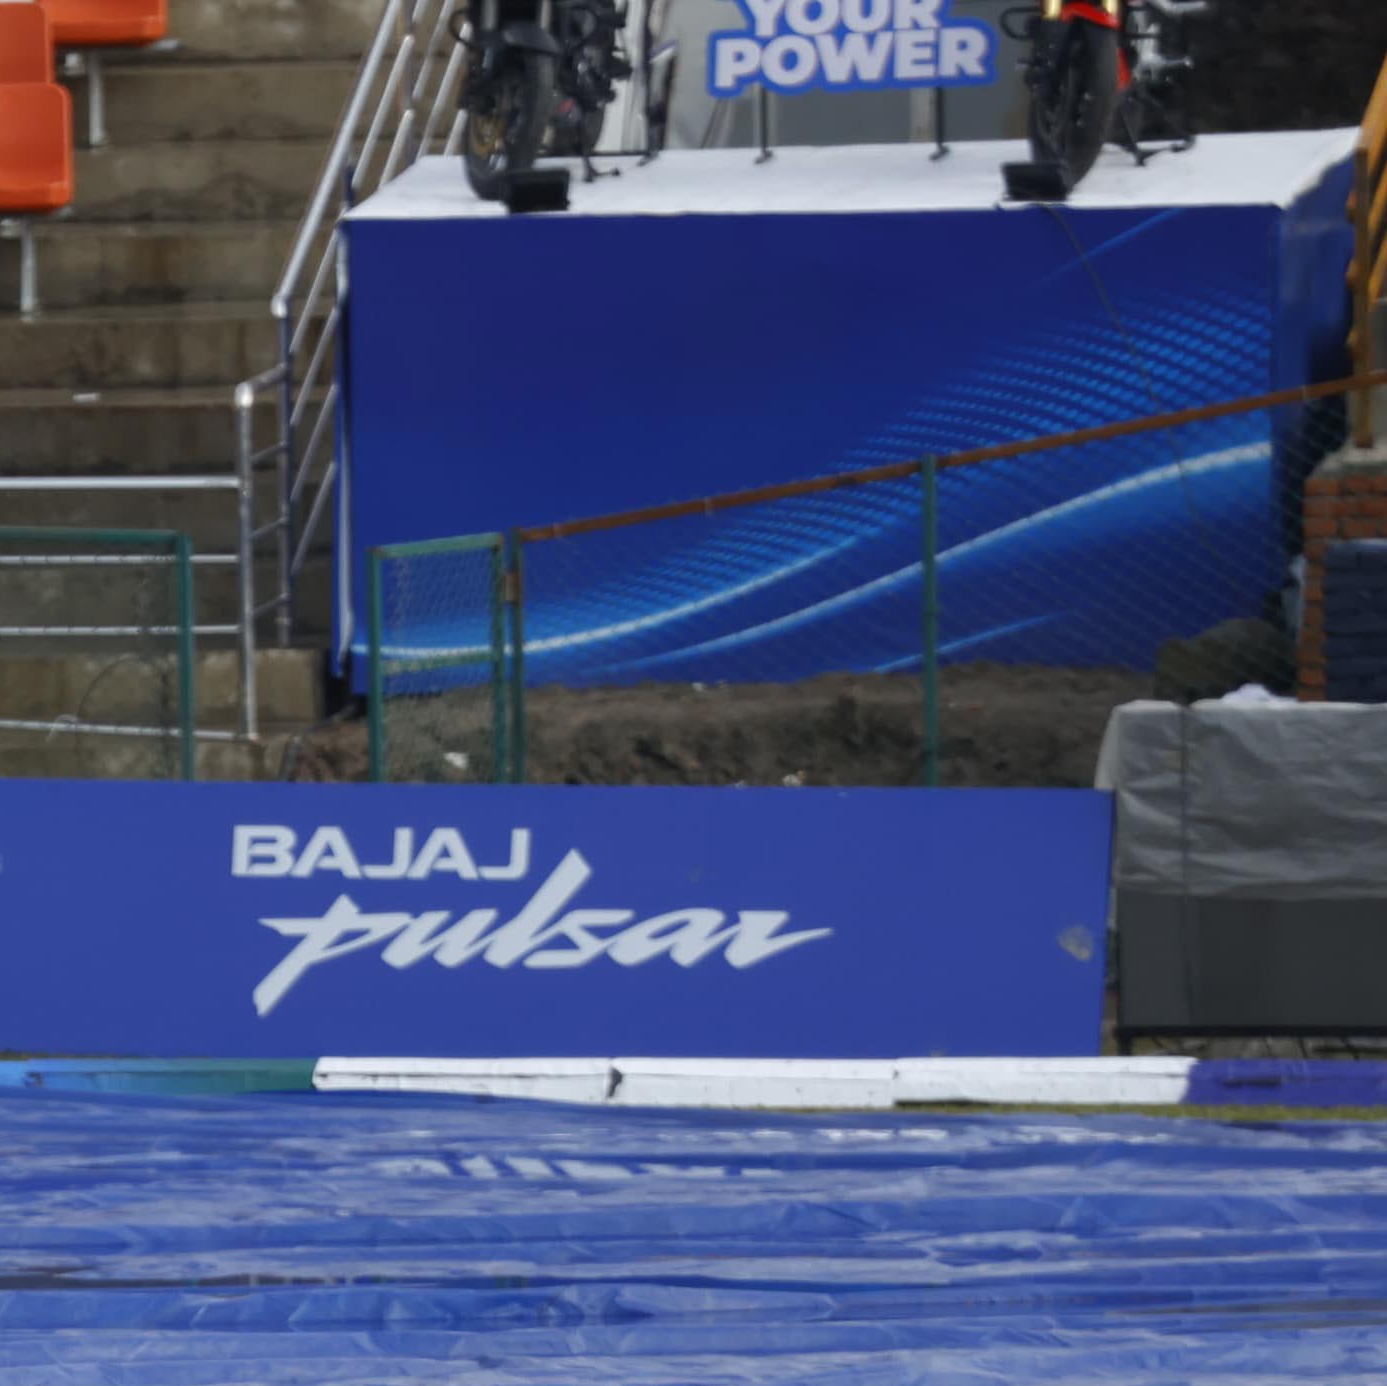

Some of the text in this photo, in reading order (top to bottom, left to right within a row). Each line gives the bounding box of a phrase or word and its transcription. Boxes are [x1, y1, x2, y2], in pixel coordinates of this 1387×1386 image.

[744, 0, 942, 36] YOUR
[714, 27, 987, 88] POWER
[231, 825, 531, 880] BAJAJ
[253, 848, 833, 1017] pulsar
